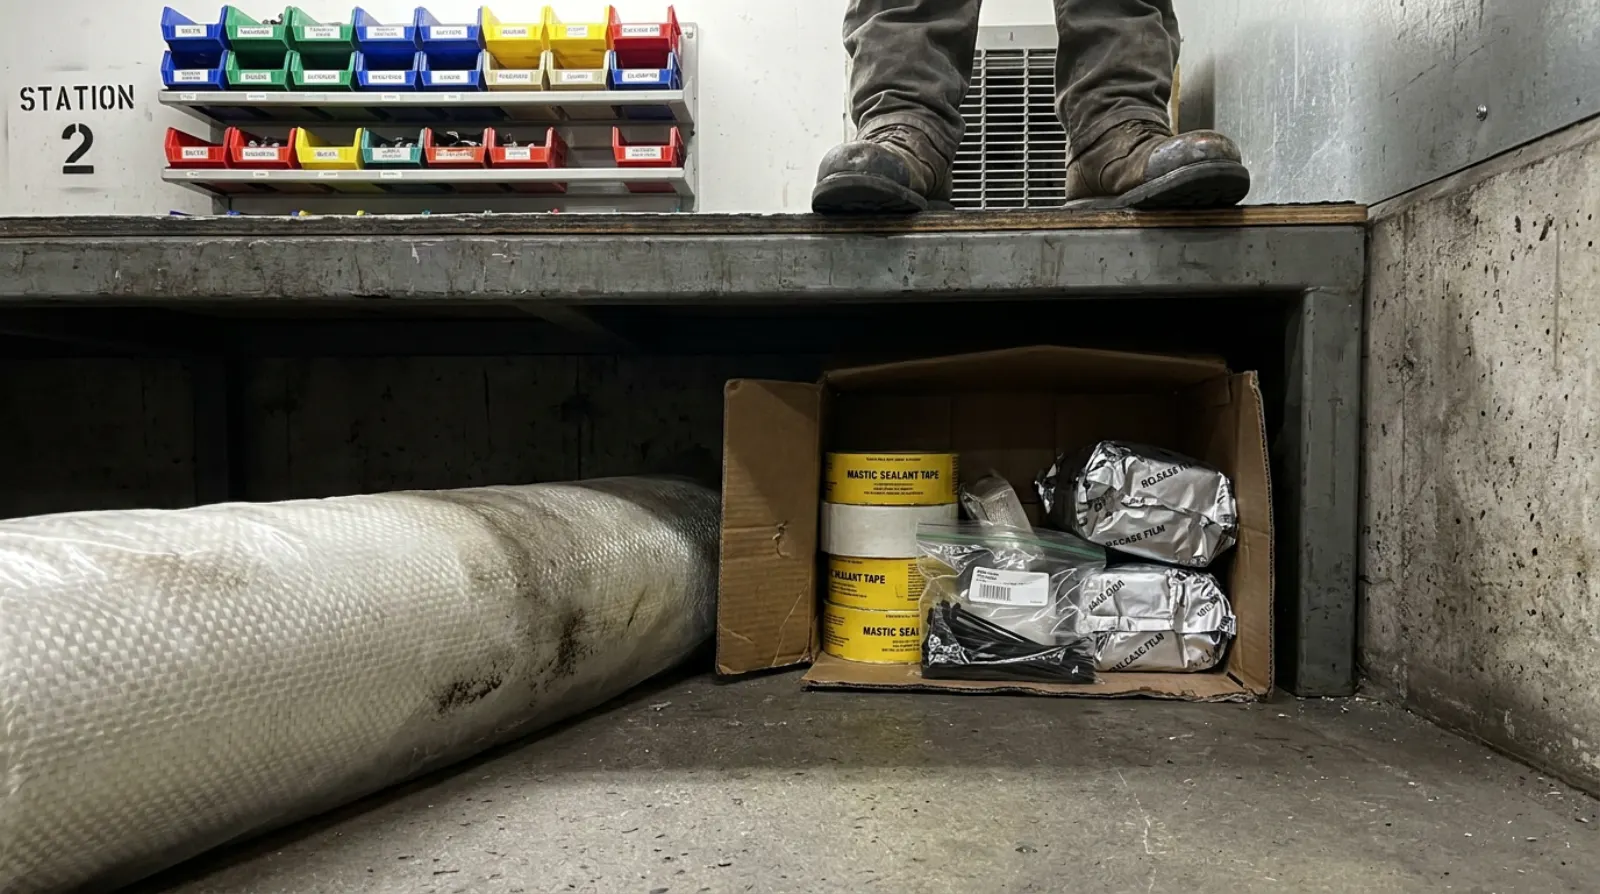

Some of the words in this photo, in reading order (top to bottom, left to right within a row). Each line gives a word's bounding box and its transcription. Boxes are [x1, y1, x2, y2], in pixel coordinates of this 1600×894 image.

[20, 84, 134, 111] STATION
[61, 123, 95, 174] 2
[847, 469, 878, 480] MASTIC
[880, 470, 919, 480] SEALANT
[920, 470, 940, 480] TAPE
[1144, 524, 1166, 540] FILM
[864, 574, 886, 584] TAPE
[863, 626, 896, 636] MASTIC
[899, 627, 920, 637] SEAL
